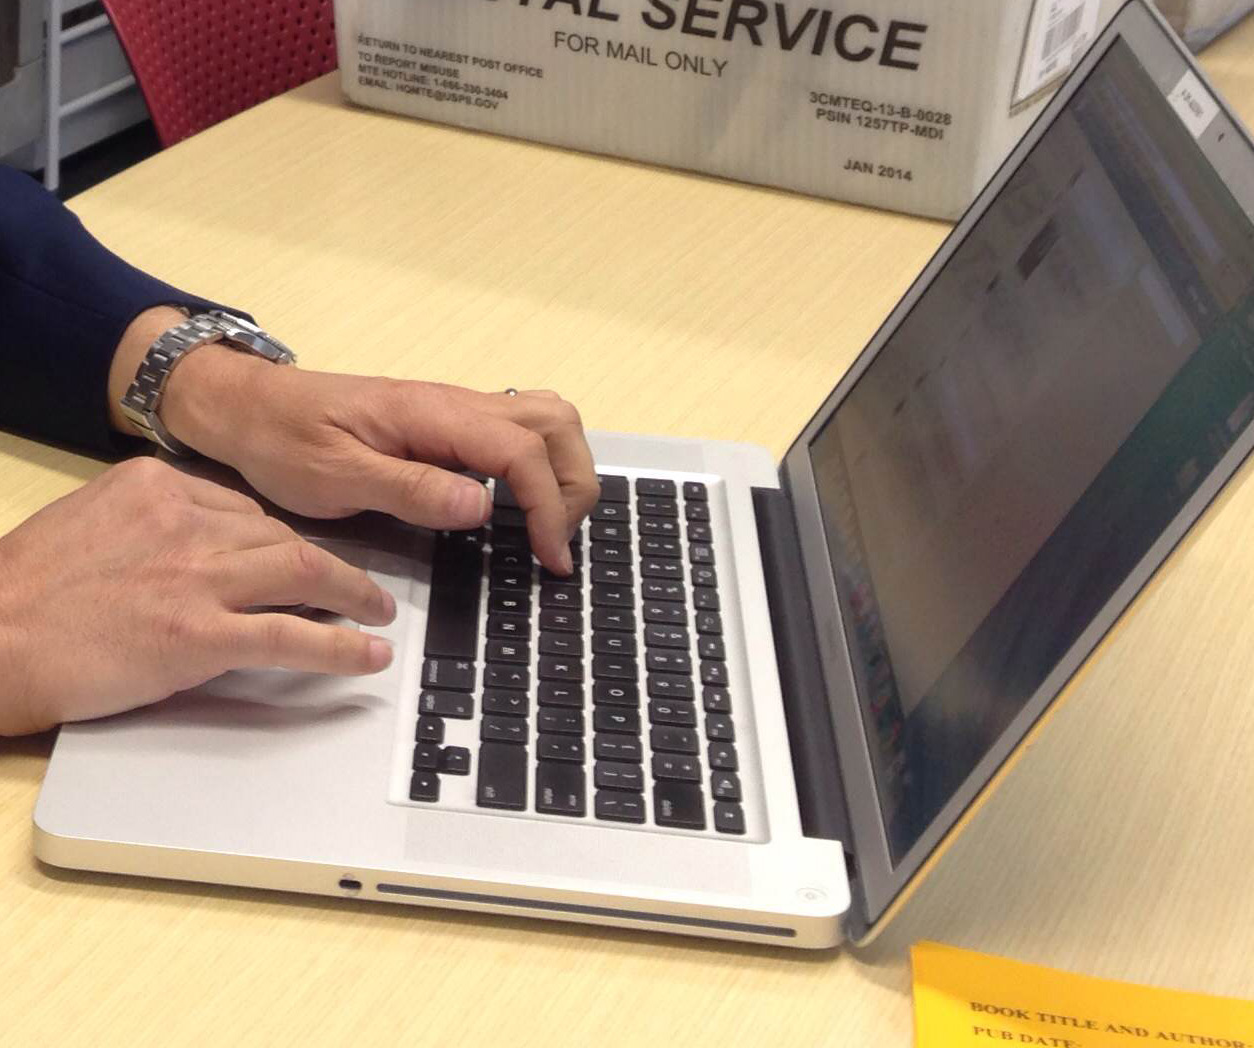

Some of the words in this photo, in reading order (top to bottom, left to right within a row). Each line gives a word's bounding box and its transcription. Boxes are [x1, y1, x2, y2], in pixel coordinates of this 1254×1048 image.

[357, 34, 401, 52] RETURN
[403, 44, 418, 55] TO
[419, 47, 469, 65] NEAREST
[472, 56, 500, 71] POST
[503, 62, 544, 79] OFFICE
[358, 51, 372, 62] TO
[374, 53, 417, 70] REPORT
[419, 63, 460, 79] MISUSE
[553, 30, 602, 56] FOR
[606, 37, 658, 66] MAIL
[664, 50, 728, 79] ONLY
[816, 108, 852, 125] PSIN
[856, 115, 944, 140] 1257TP-MDI
[843, 159, 874, 174] JAN
[877, 164, 913, 182] 2014
[969, 1001, 1031, 1021] BOOK
[1035, 1011, 1099, 1031] TITLE
[1104, 1023, 1149, 1038] AND
[972, 1025, 1014, 1041] PUB
